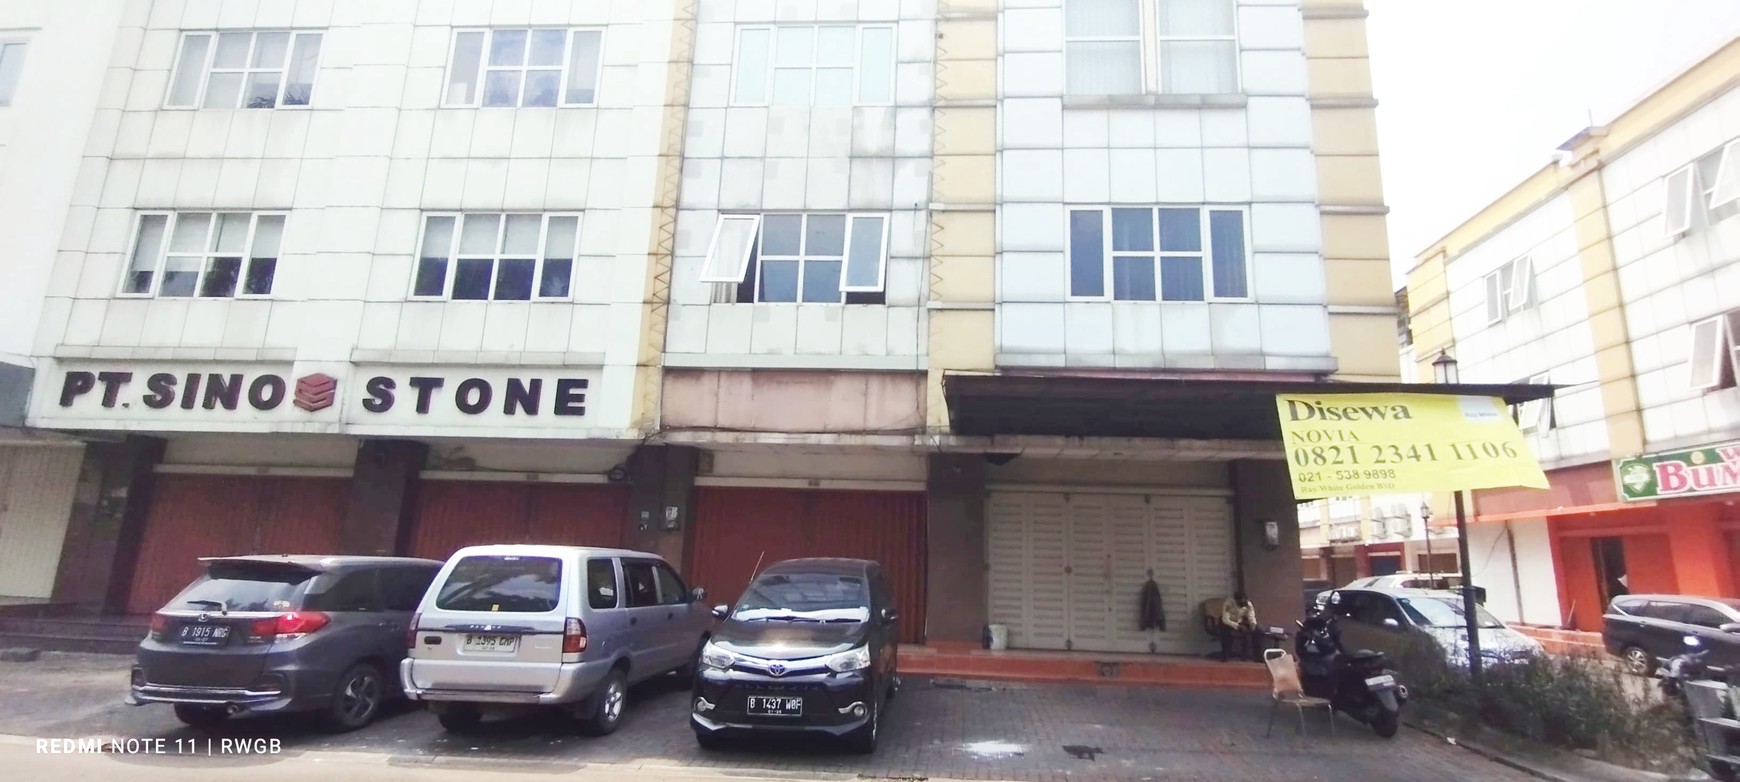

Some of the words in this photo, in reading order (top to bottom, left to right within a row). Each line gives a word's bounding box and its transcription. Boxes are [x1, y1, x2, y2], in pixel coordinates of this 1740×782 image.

[142, 373, 286, 411] SINO
[362, 376, 589, 416] STONE
[1286, 399, 1413, 421] Disewa
[1291, 430, 1361, 444] NOVIA
[1294, 445, 1360, 467] 0821
[1371, 442, 1438, 464] 2341
[1448, 441, 1518, 460] 1106
[1298, 472, 1322, 482] 021
[1336, 470, 1360, 480] 538
[1363, 469, 1396, 479] 9898
[181, 627, 189, 637] B
[192, 627, 211, 637] 1915
[750, 698, 756, 709] B
[763, 698, 781, 709] 1437
